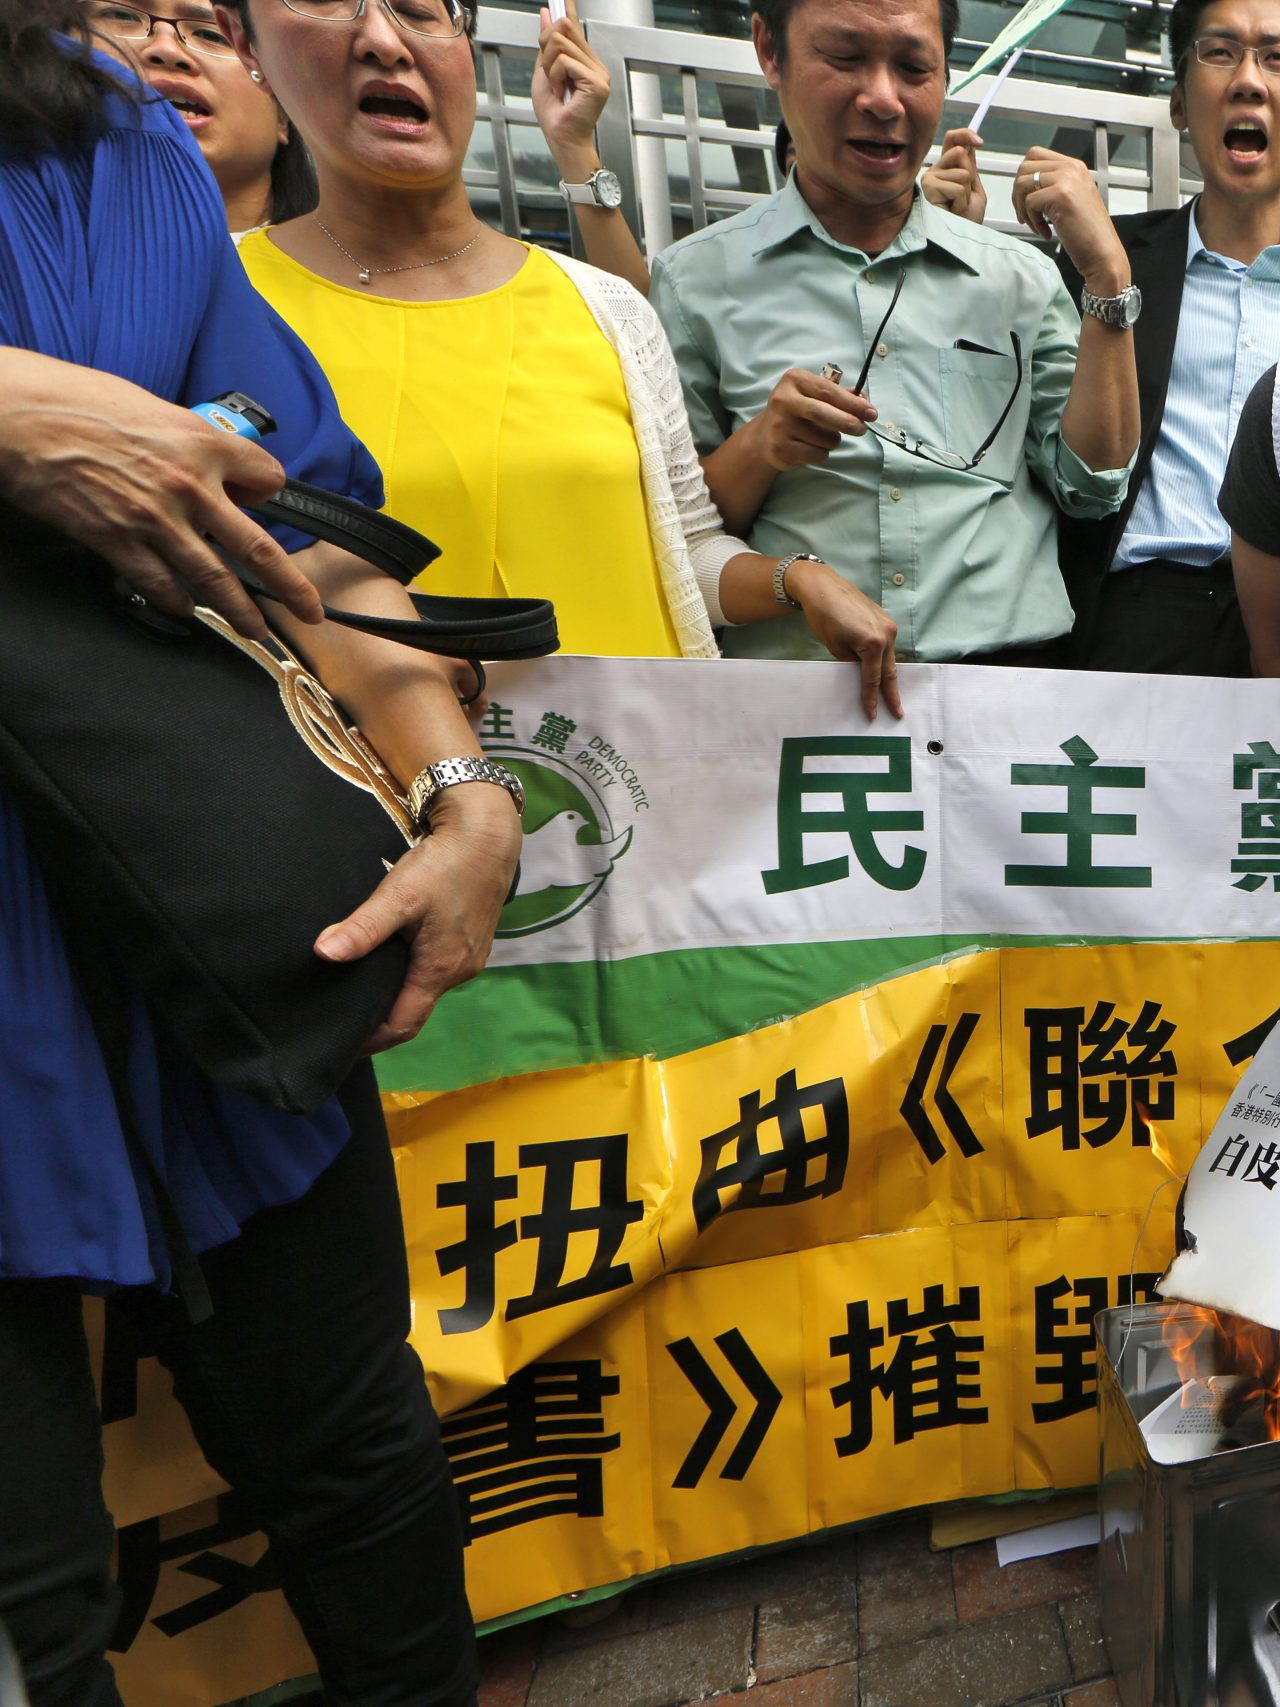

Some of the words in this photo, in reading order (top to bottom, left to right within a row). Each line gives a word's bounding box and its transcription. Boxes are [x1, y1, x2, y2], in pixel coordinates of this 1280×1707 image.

[479, 702, 577, 754] 主黨
[575, 751, 617, 788] PARTY
[588, 736, 650, 813] DEMOCRATIC
